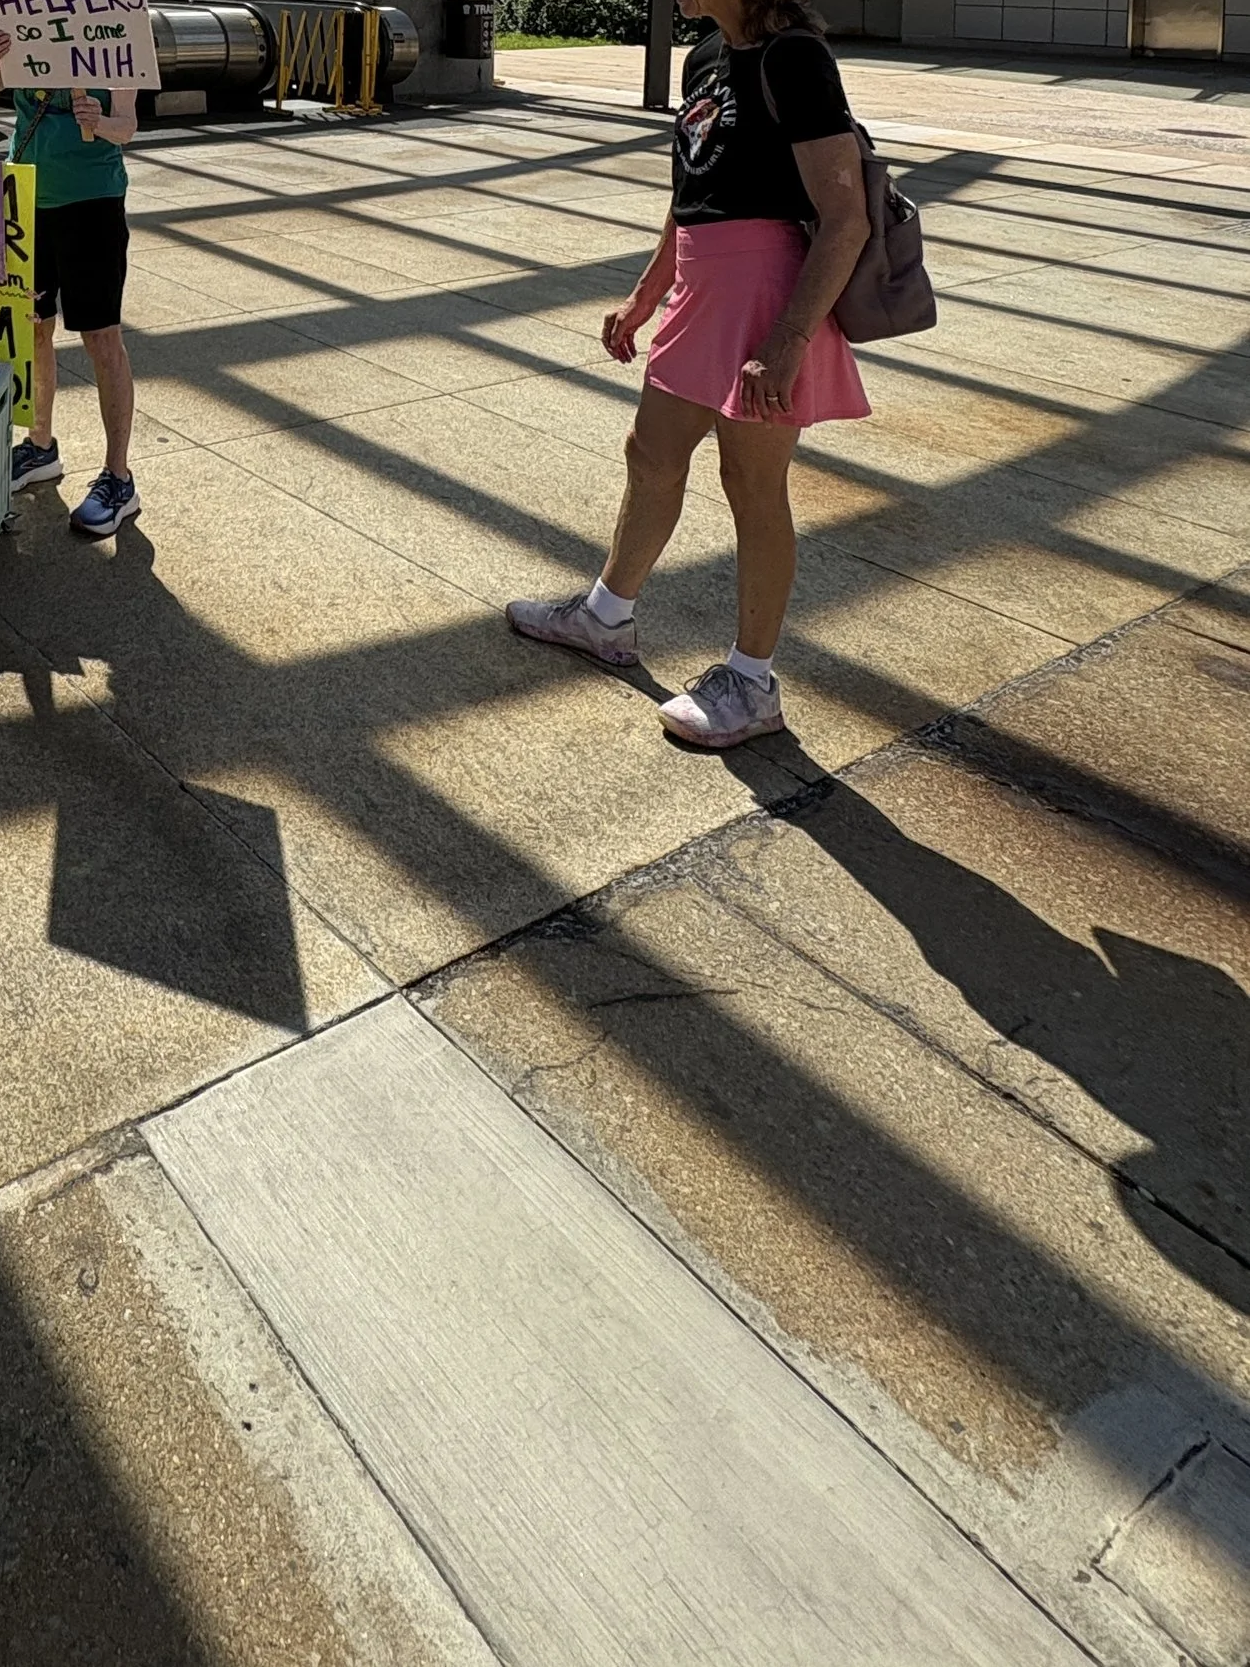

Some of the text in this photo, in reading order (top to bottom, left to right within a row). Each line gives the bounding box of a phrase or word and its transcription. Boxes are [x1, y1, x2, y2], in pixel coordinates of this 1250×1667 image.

[16, 17, 127, 43] so I came
[23, 43, 146, 79] to NIH.
